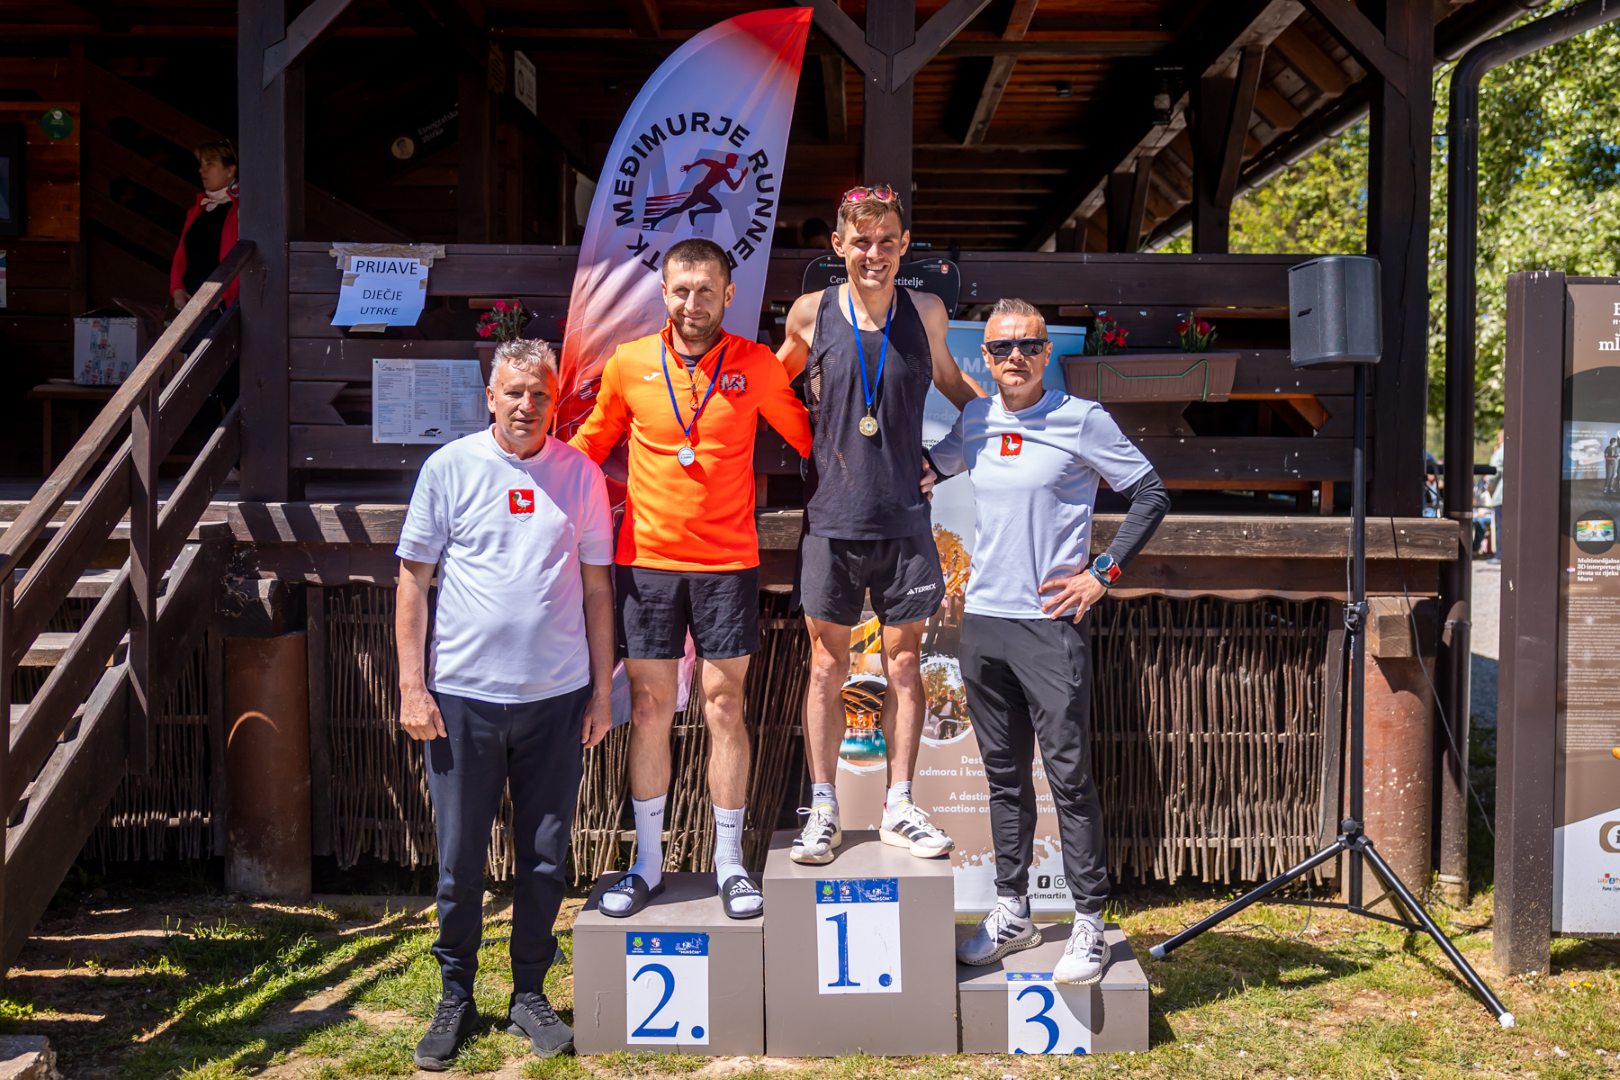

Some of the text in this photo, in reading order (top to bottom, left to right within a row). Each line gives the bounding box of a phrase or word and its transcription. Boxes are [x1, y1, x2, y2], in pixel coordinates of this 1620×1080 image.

[612, 112, 750, 227] MEĐIMURJE
[625, 233, 661, 272] TK
[355, 260, 418, 275] PRIJAVE
[829, 275, 924, 288] Cen etitelje
[362, 288, 403, 301] DJEČJE
[359, 306, 399, 316] UTRKE
[1598, 337, 1620, 351] ml
[914, 583, 936, 594] TERREX
[960, 755, 984, 765] Dest
[919, 767, 957, 777] odmora
[949, 792, 957, 801] A
[959, 792, 990, 801] destin
[932, 805, 976, 813] vacation
[1036, 804, 1057, 813] livin
[1029, 892, 1067, 900] etimartin
[825, 911, 893, 987] 1.
[631, 963, 705, 1039] 2.
[1014, 984, 1087, 1054] 3.
